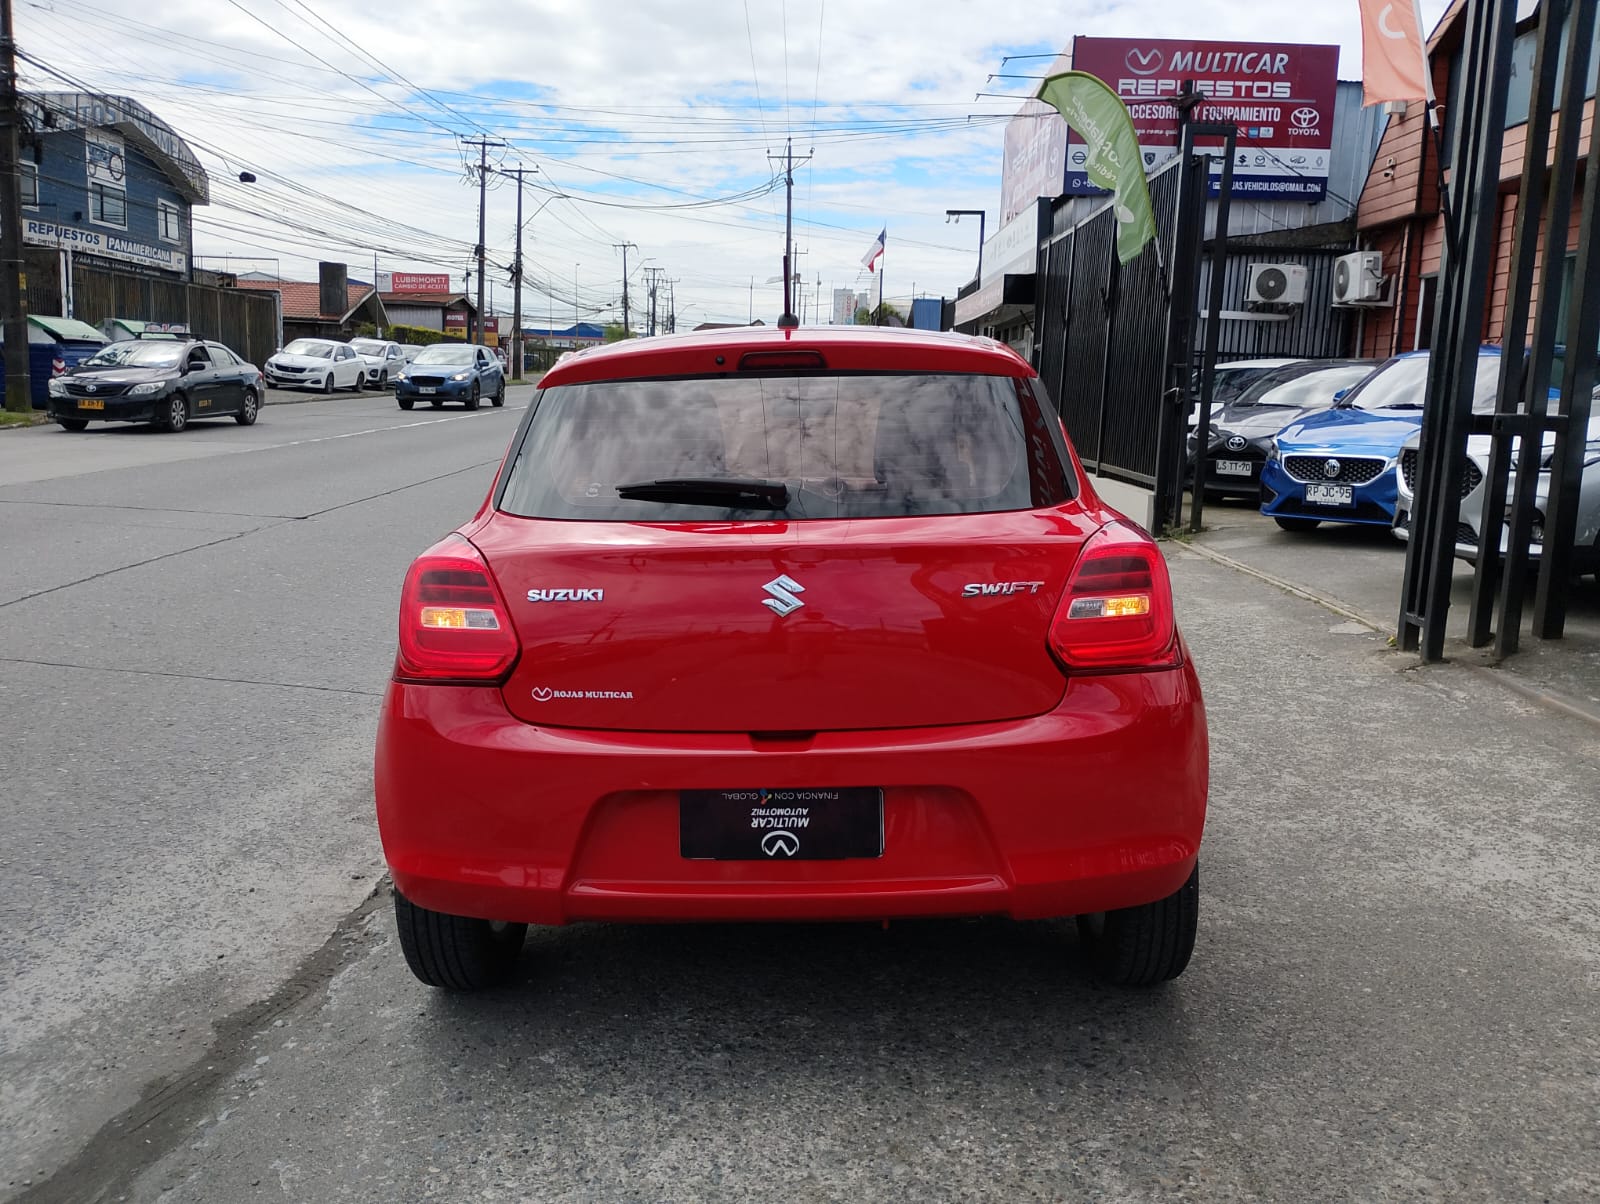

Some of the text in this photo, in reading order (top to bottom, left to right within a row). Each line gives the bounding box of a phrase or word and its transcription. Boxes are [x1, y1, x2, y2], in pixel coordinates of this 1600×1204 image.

[1168, 51, 1289, 74] MULTICAR
[1193, 106, 1202, 120] Y
[1288, 127, 1321, 136] TOYOTA
[28, 221, 100, 246] REPUESTOS
[108, 236, 171, 262] PANAMERICANA
[395, 274, 446, 284] LUBRIMONTT
[961, 581, 1045, 597] SWIFT
[527, 588, 604, 602] SUZUKI
[553, 690, 634, 699] ROJAS MULTICAR
[721, 791, 839, 800] FINANCIA CON GLOBAL
[751, 807, 809, 816] AUTOMOTRIZ
[751, 817, 810, 828] MULTICAR
